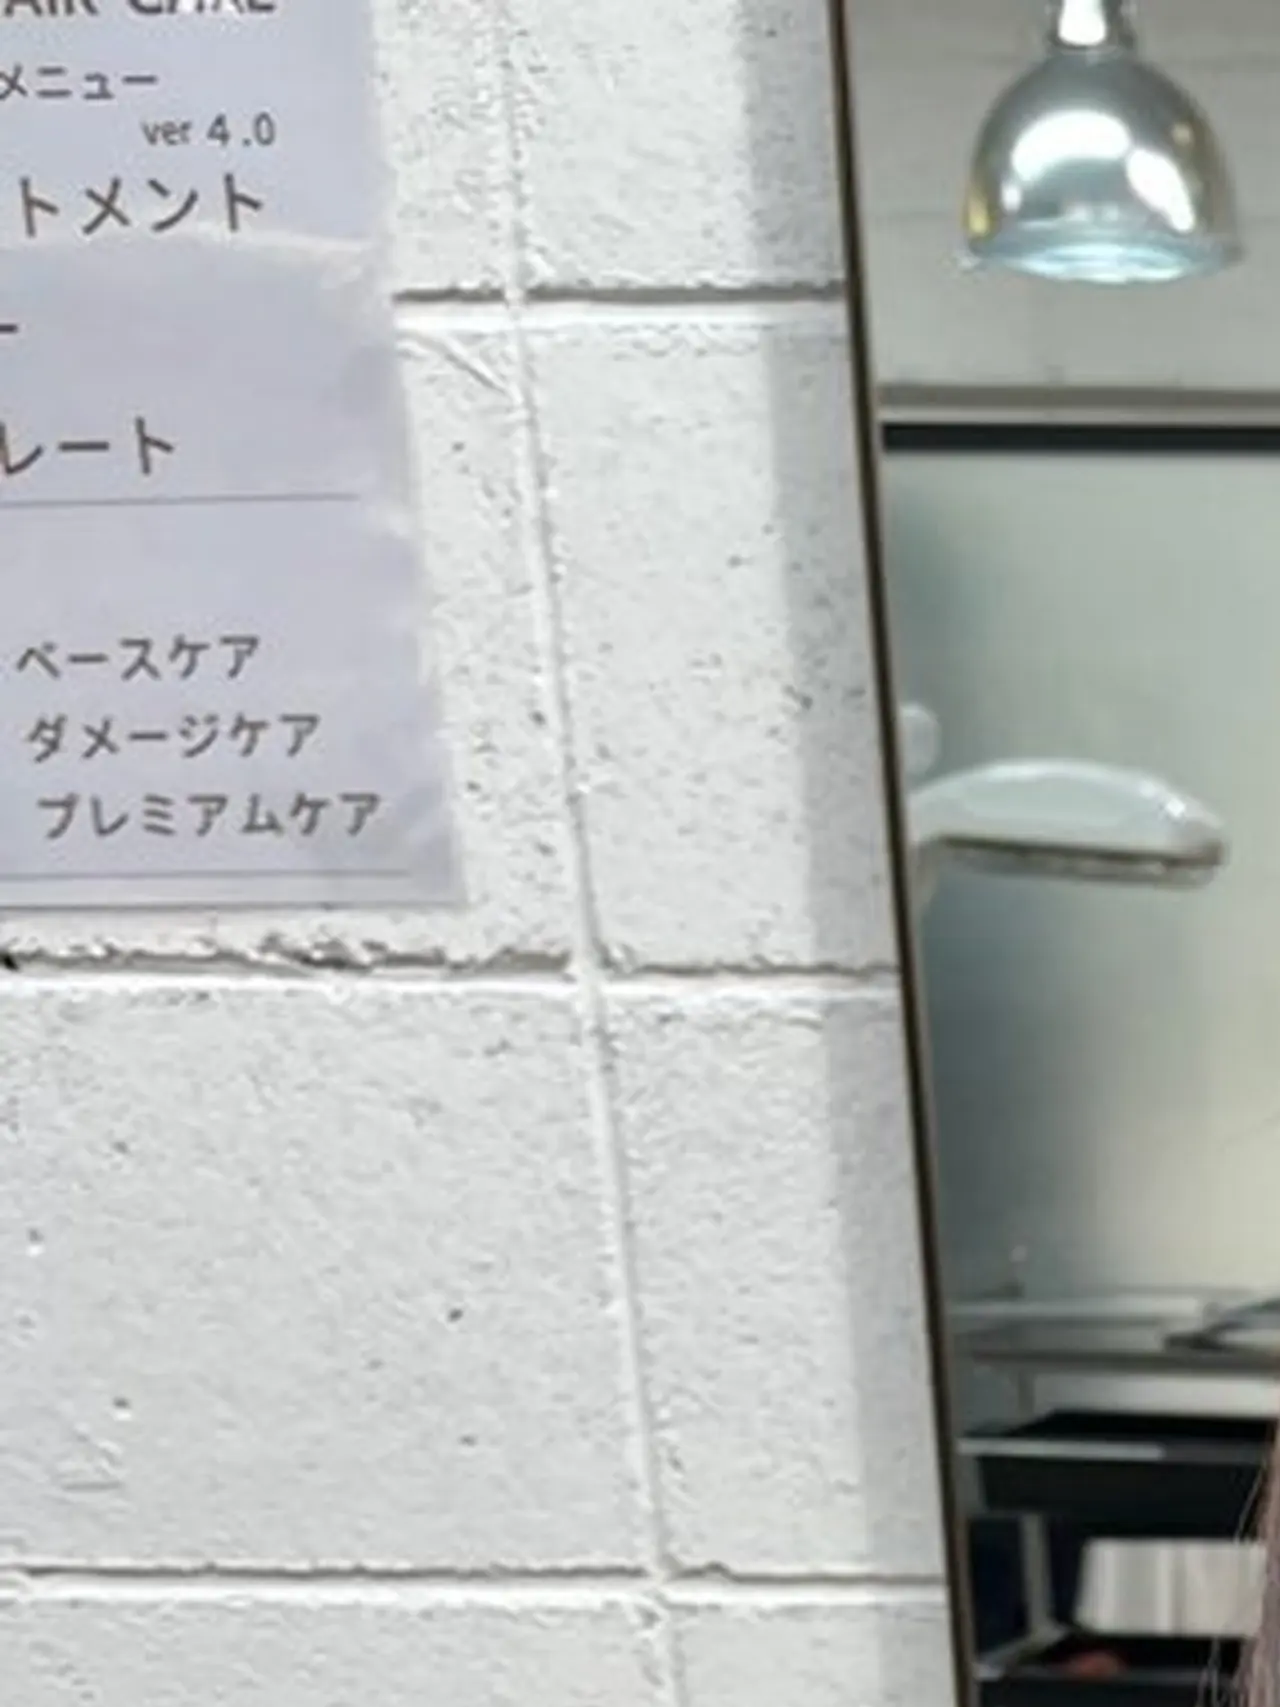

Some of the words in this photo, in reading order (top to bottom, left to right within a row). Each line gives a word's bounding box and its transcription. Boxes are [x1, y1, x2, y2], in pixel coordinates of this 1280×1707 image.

[0, 64, 157, 101] メニュー
[142, 121, 192, 145] ver
[207, 112, 275, 146] 4.0
[20, 173, 263, 237] トメント
[0, 417, 174, 476] レート
[16, 635, 259, 680] ベースケア
[27, 713, 320, 763] ダメージケア
[38, 793, 380, 839] プレミアムケア
